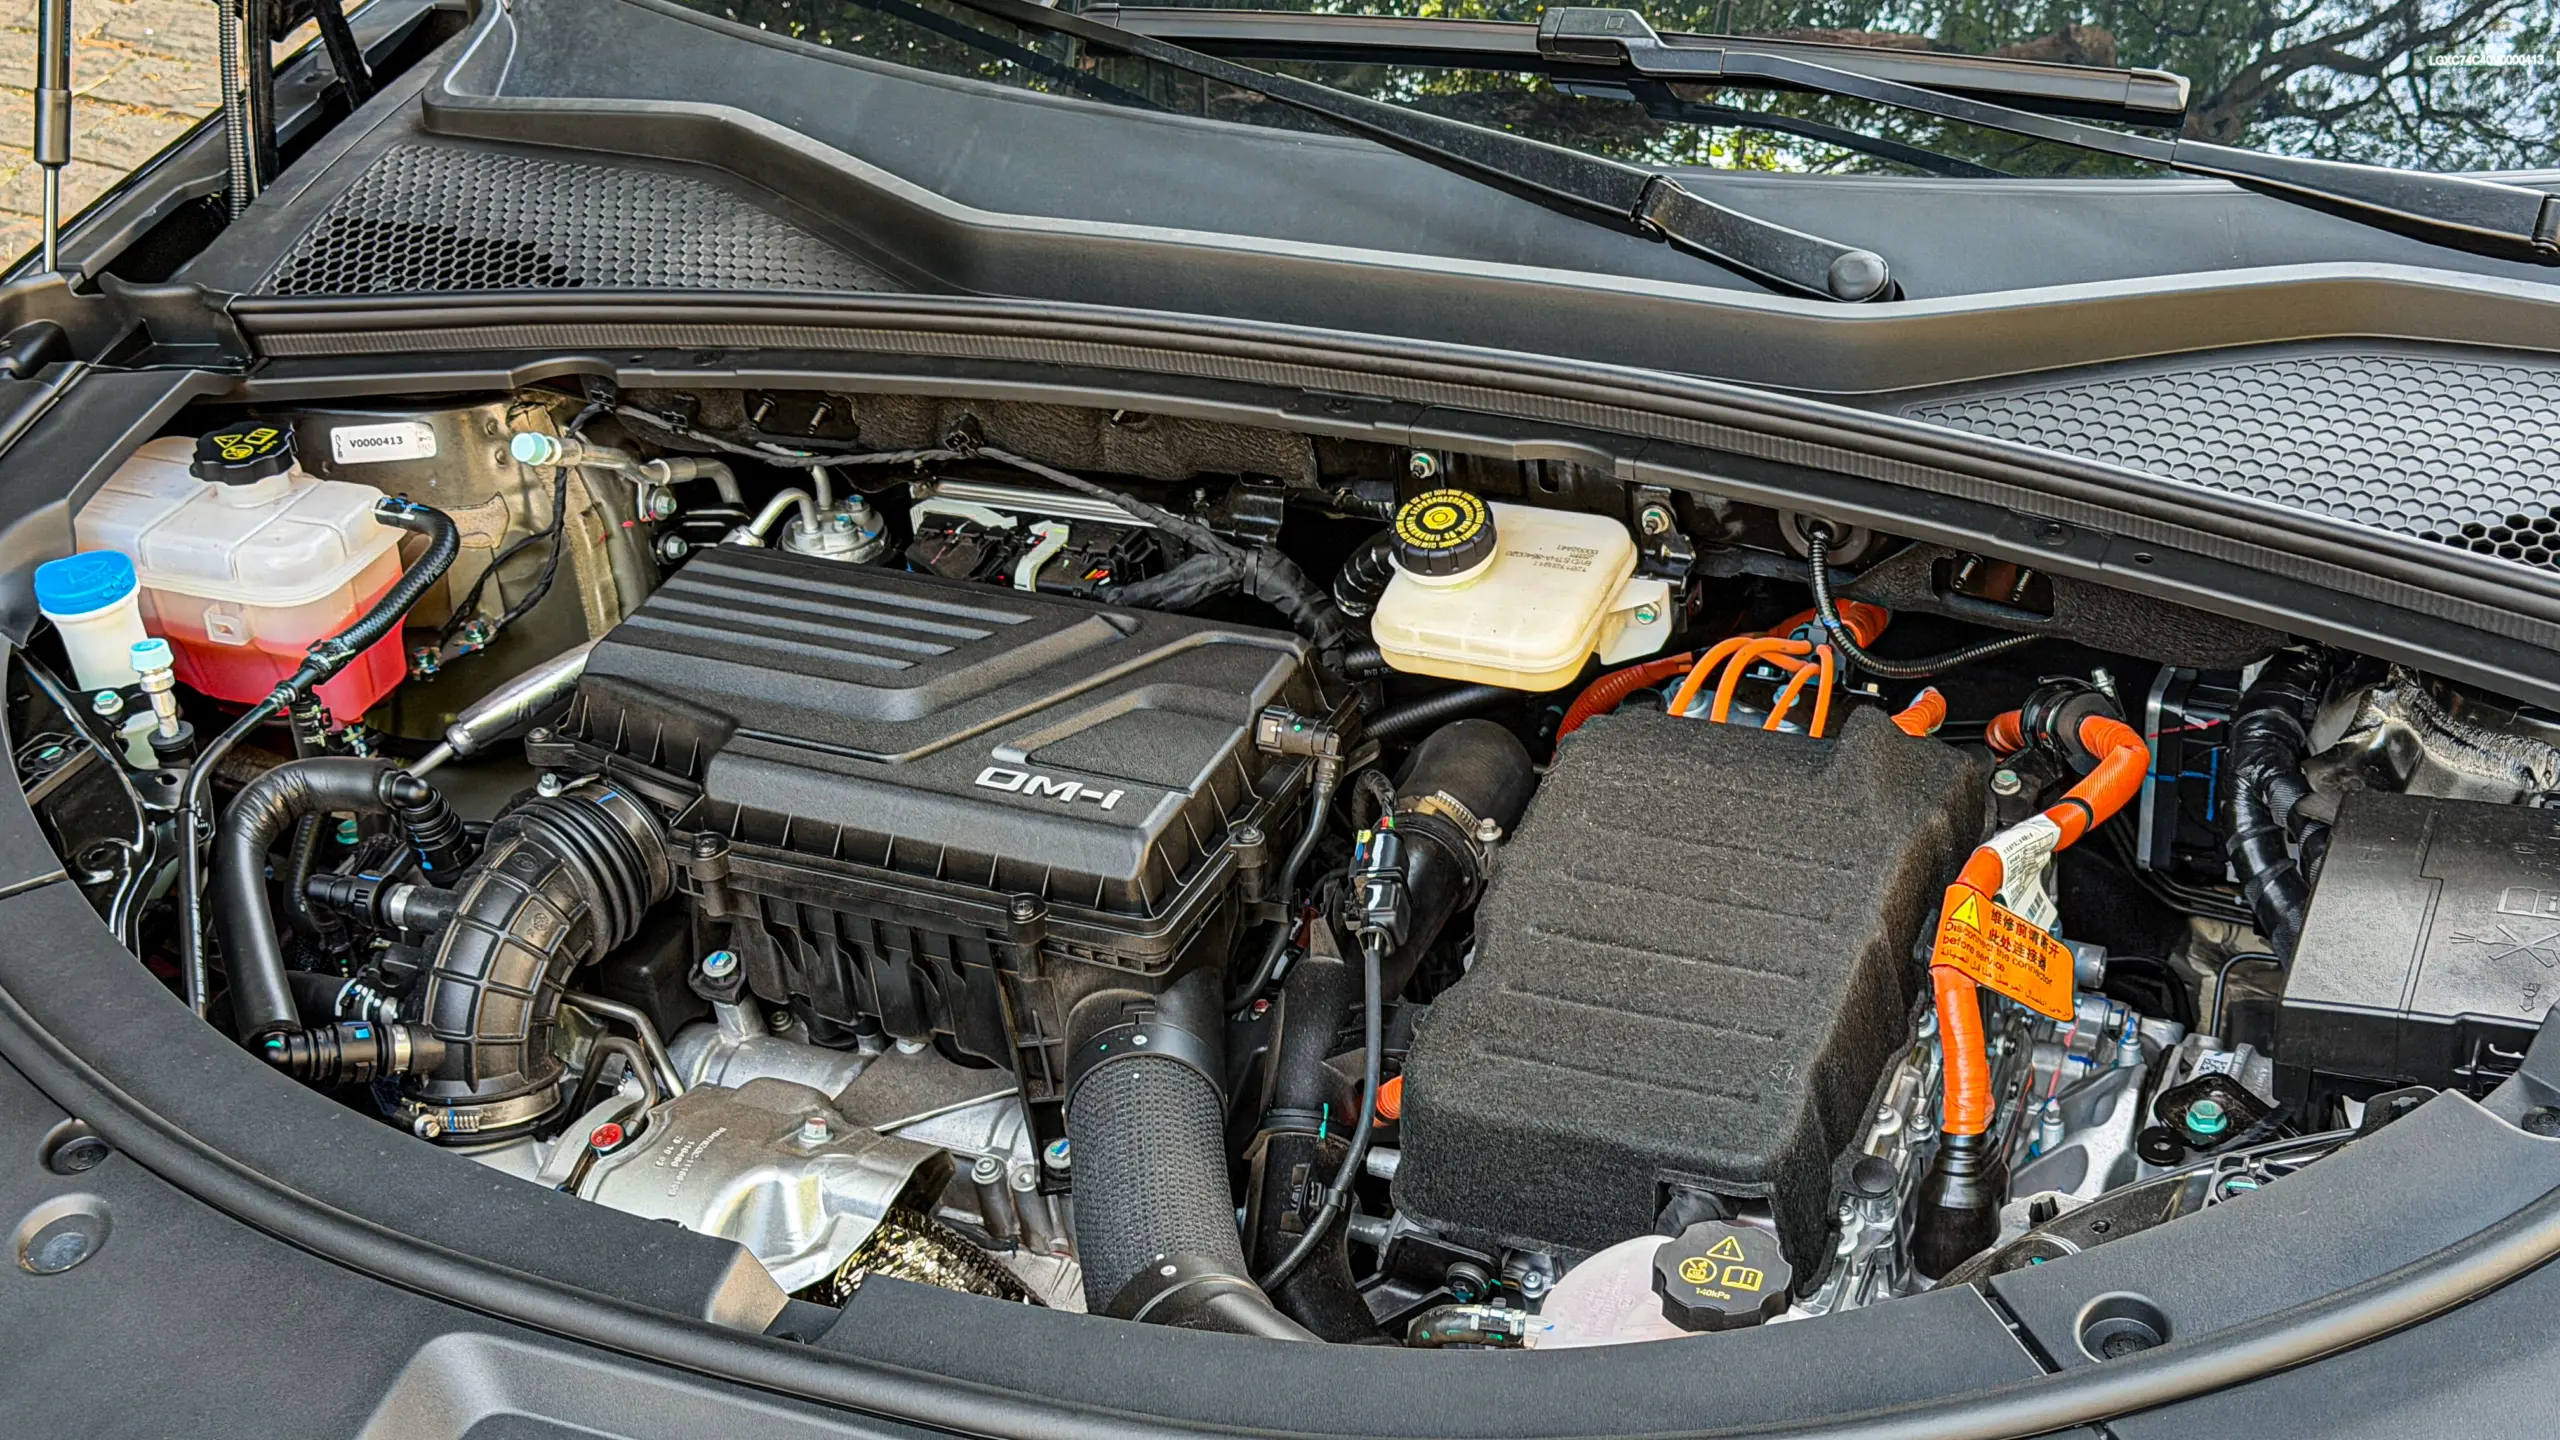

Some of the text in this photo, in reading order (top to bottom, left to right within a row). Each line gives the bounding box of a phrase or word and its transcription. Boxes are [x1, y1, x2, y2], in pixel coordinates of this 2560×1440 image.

[349, 436, 404, 449] V0000413
[974, 766, 1125, 810] DM-i
[1943, 934, 2006, 972] before service
[1944, 922, 2053, 986] Disconnect the connector
